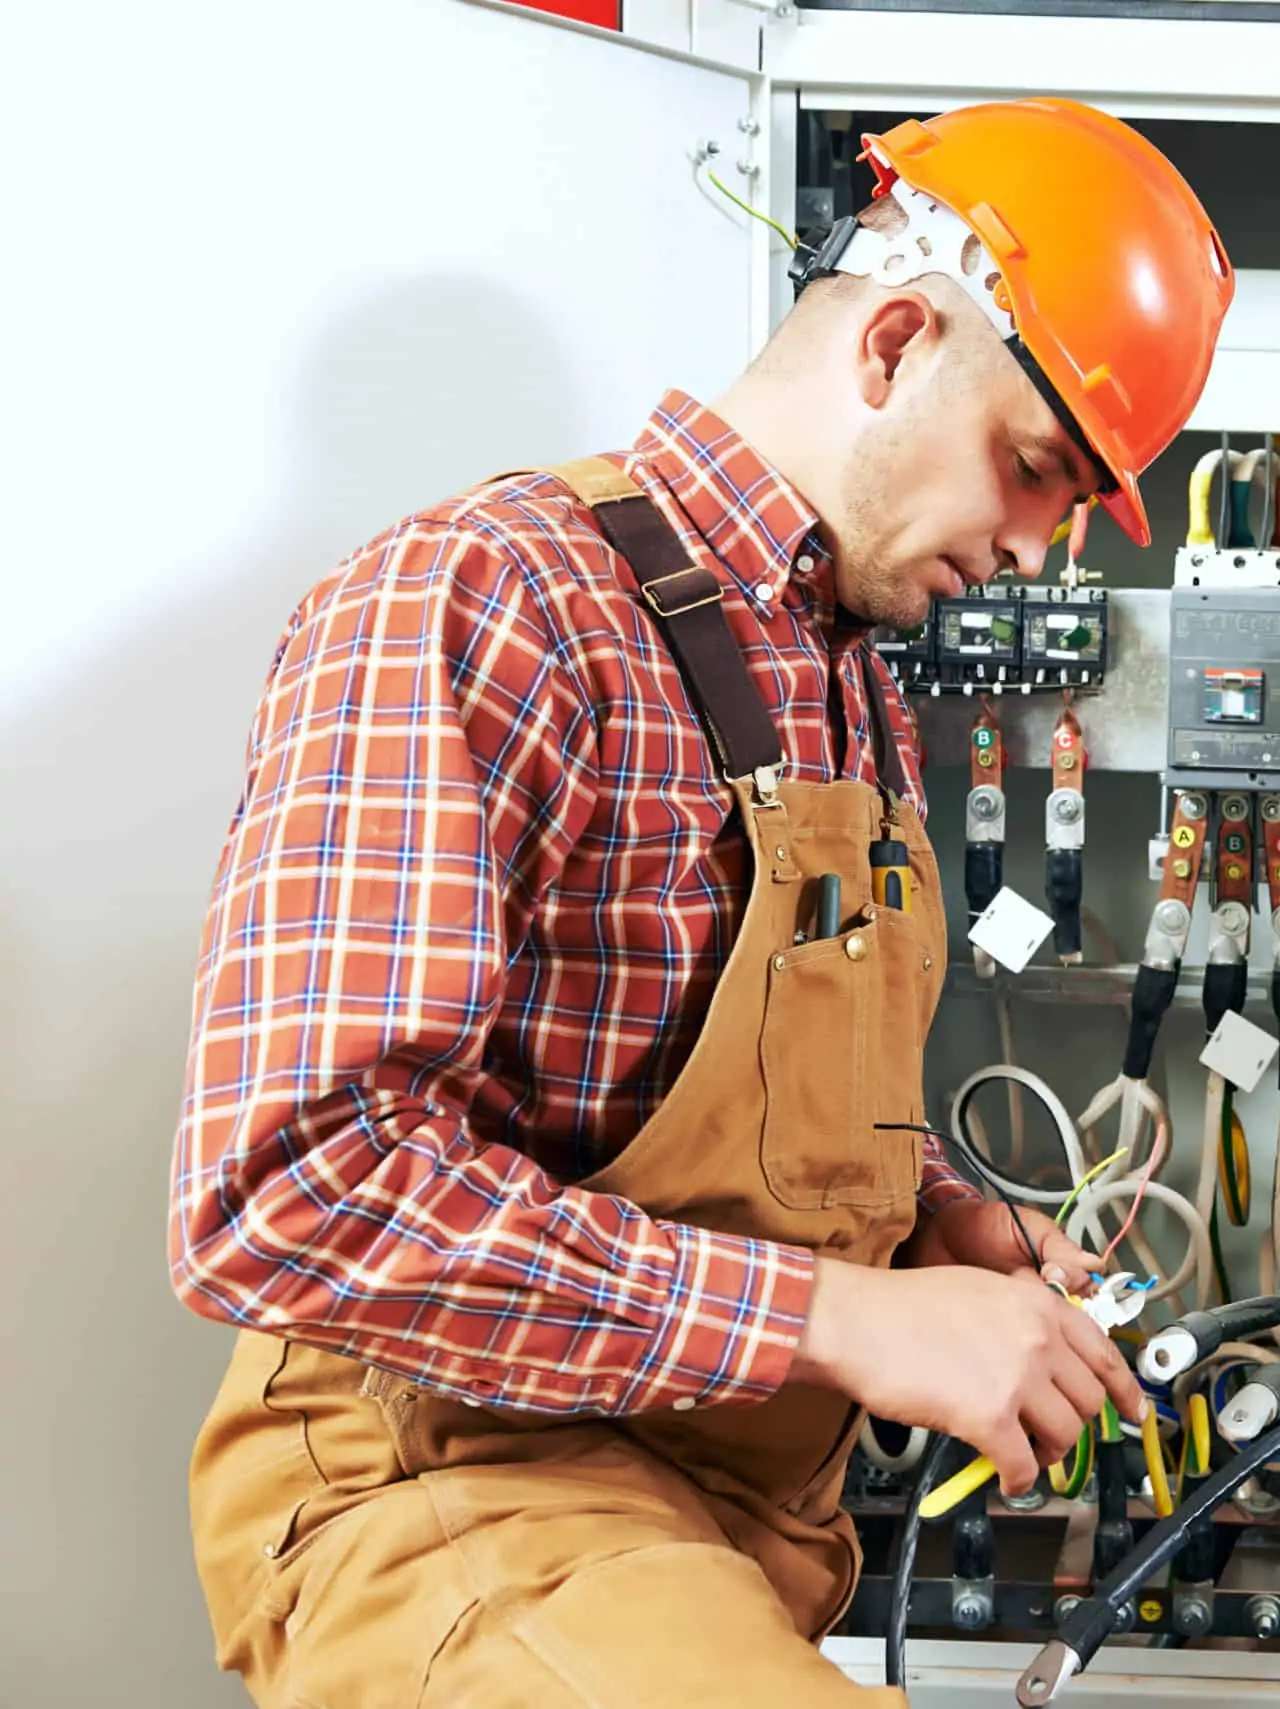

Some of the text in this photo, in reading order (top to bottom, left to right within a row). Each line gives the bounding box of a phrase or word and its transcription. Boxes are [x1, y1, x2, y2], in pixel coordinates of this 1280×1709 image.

[978, 731, 990, 746] B
[1058, 733, 1071, 748] C
[1178, 830, 1190, 843] A
[1229, 836, 1241, 851] B
